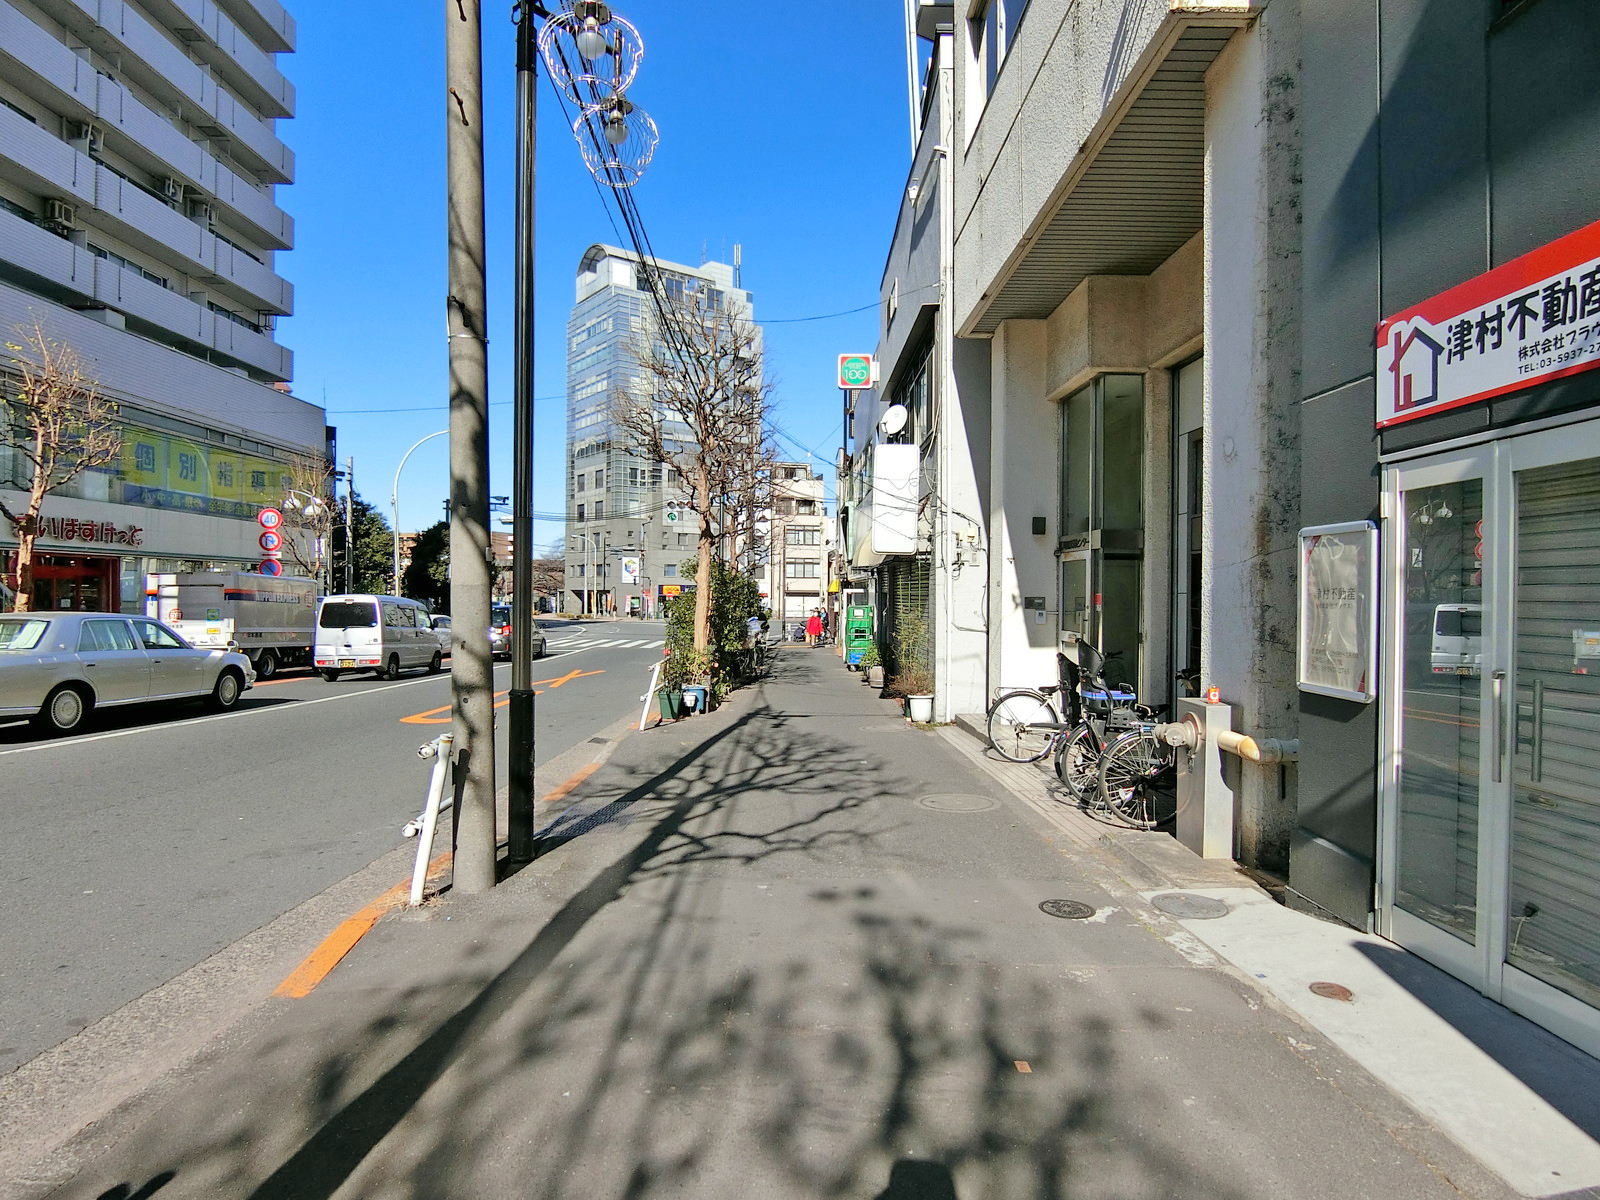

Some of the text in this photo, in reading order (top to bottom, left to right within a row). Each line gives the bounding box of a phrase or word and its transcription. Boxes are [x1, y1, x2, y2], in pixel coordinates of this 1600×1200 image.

[844, 369, 867, 380] 100
[264, 514, 277, 524] 40
[13, 515, 144, 546] いばすけっと
